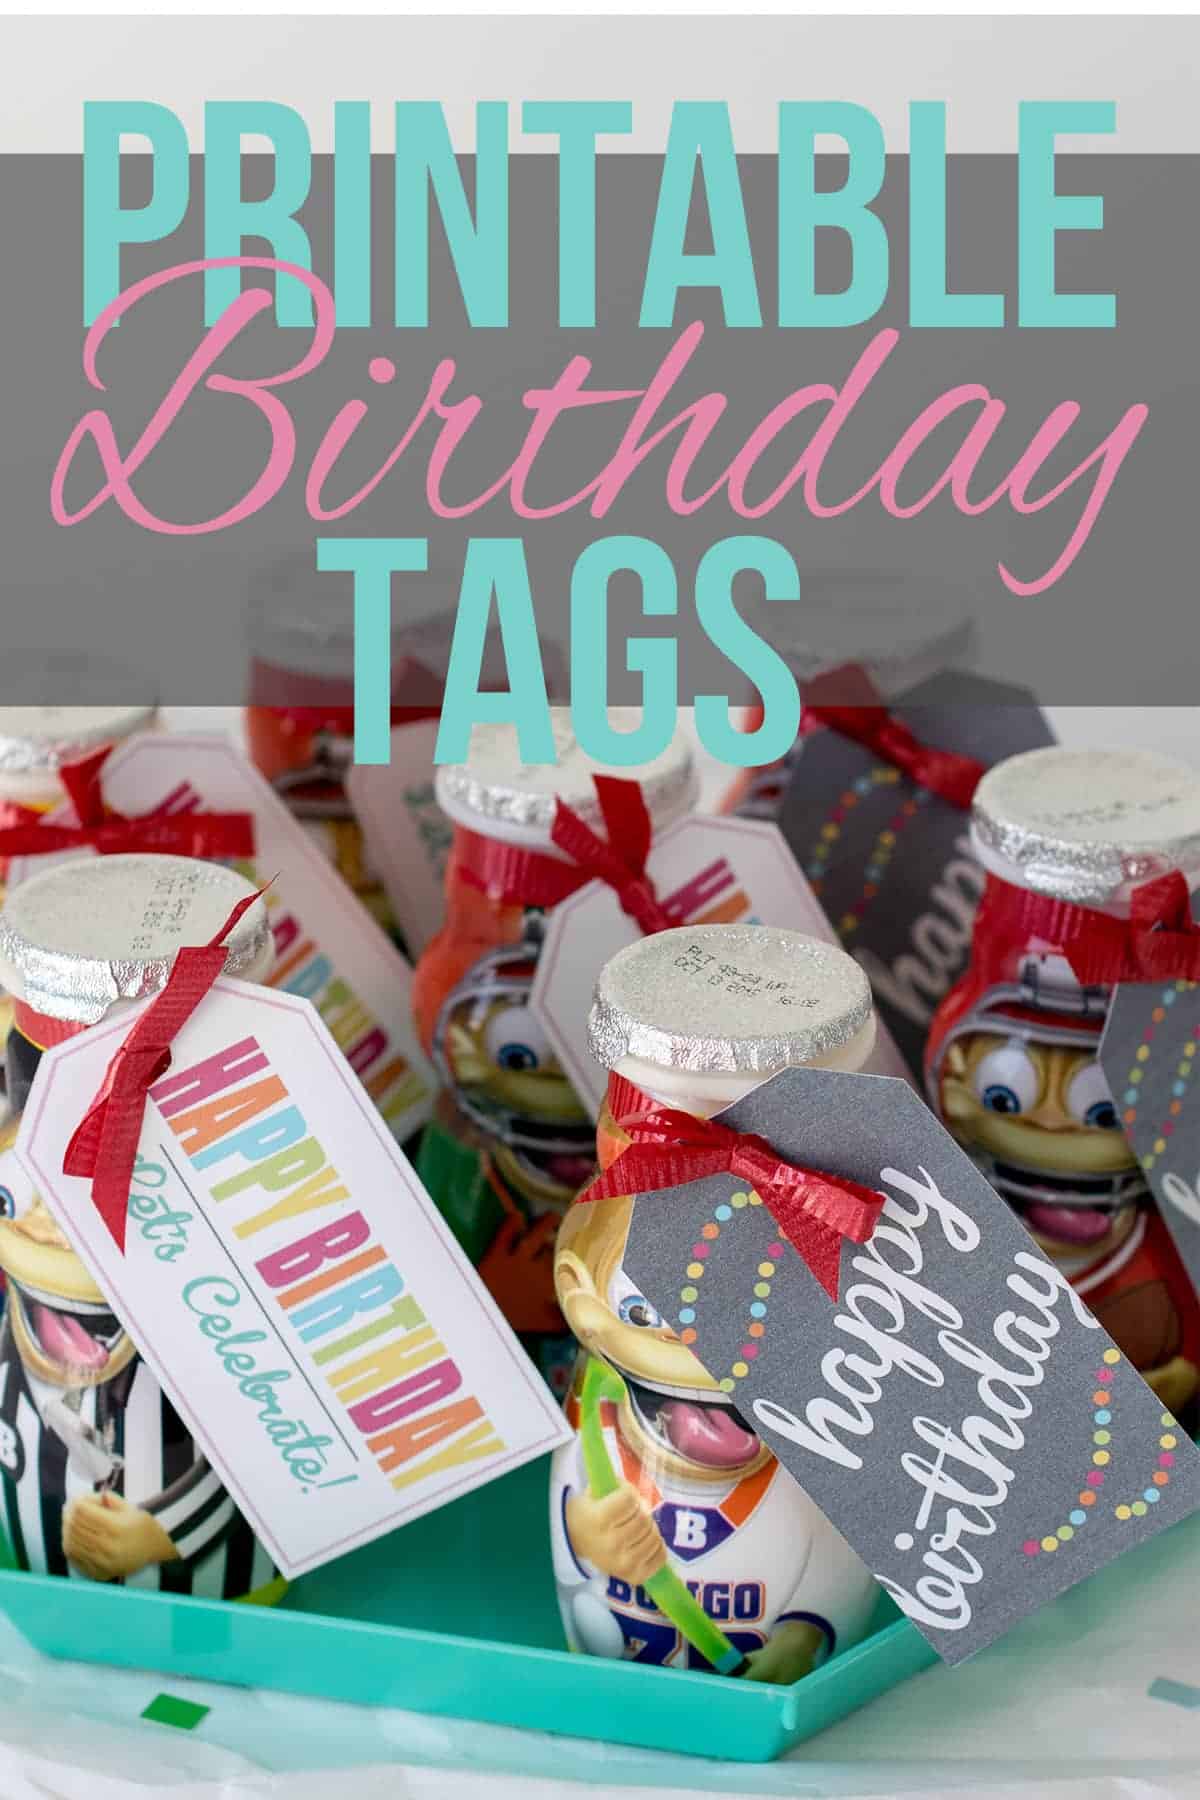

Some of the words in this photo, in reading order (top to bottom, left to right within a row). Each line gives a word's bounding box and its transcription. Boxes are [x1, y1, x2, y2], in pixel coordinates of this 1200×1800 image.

[147, 1035, 351, 1240] HAPPY
[254, 1209, 508, 1491] BIRTHDAY
[181, 1275, 359, 1495] Celebrate!
[753, 1165, 981, 1470] happy
[673, 1509, 708, 1550] B
[874, 1252, 1101, 1631] birthday
